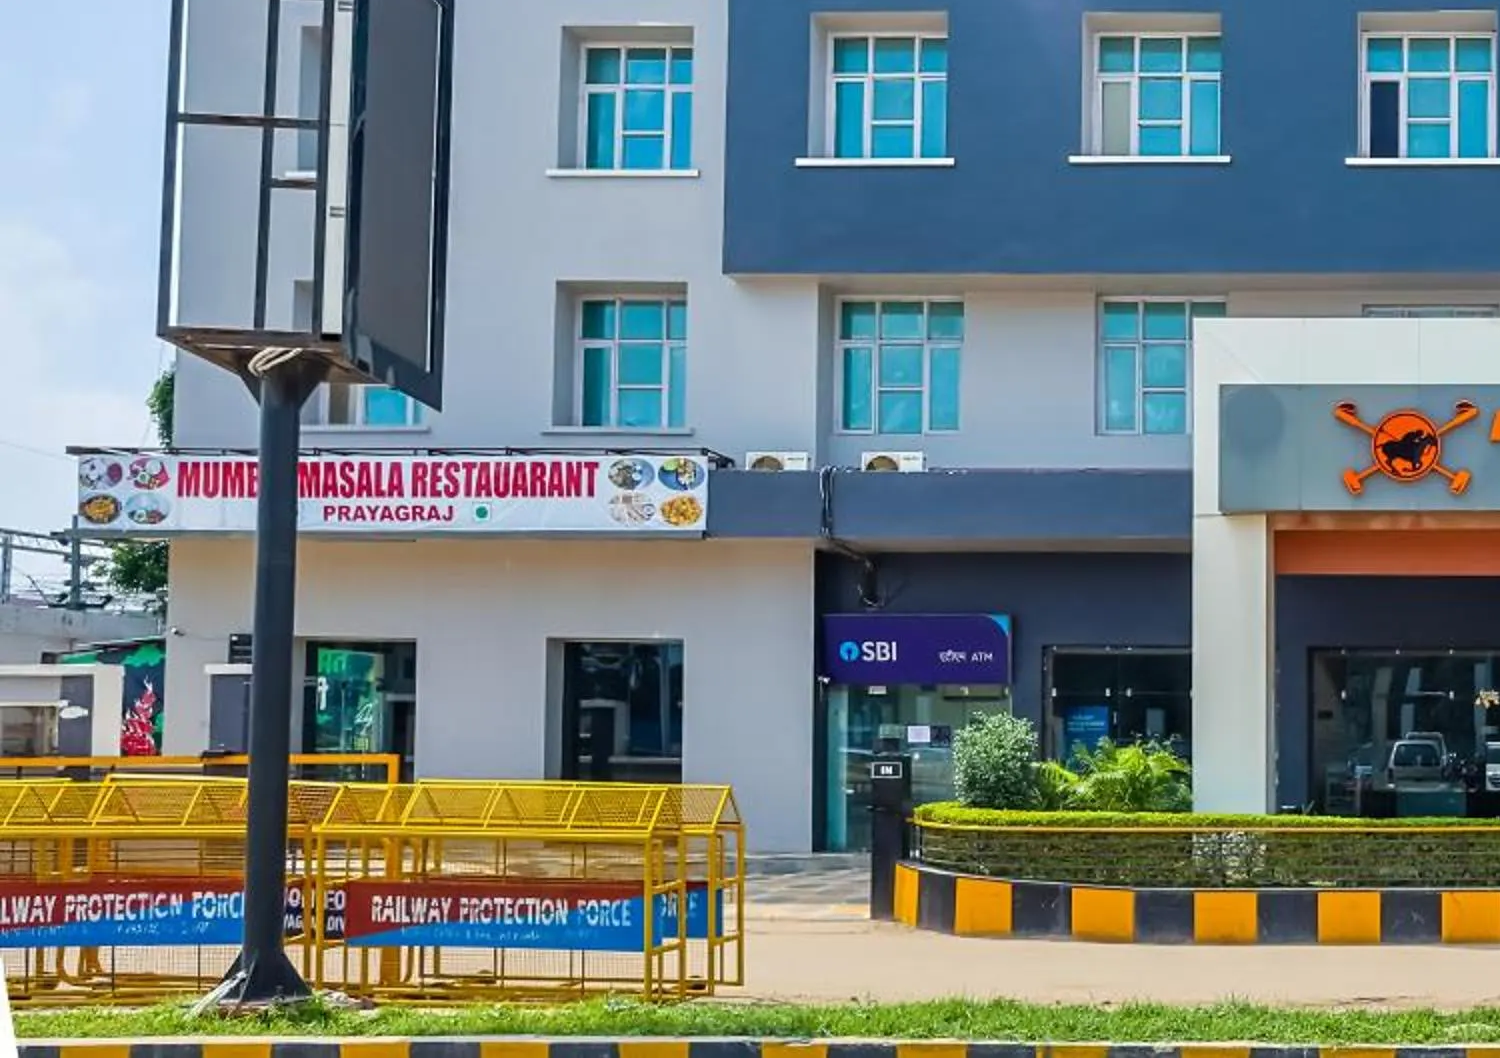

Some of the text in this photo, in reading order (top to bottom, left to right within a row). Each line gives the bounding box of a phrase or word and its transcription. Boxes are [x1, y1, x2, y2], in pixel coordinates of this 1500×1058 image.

[177, 461, 599, 498] MUMB MASALA RESTAUARANT
[323, 505, 454, 522] PRAYAGRAJ
[861, 641, 897, 662] SBI
[971, 652, 993, 662] ATM
[0, 891, 245, 924] LWAY PROTECTION FORC
[371, 895, 452, 924] RAILWAY
[459, 896, 568, 926] PROTECTION
[576, 898, 632, 927] FORCE
